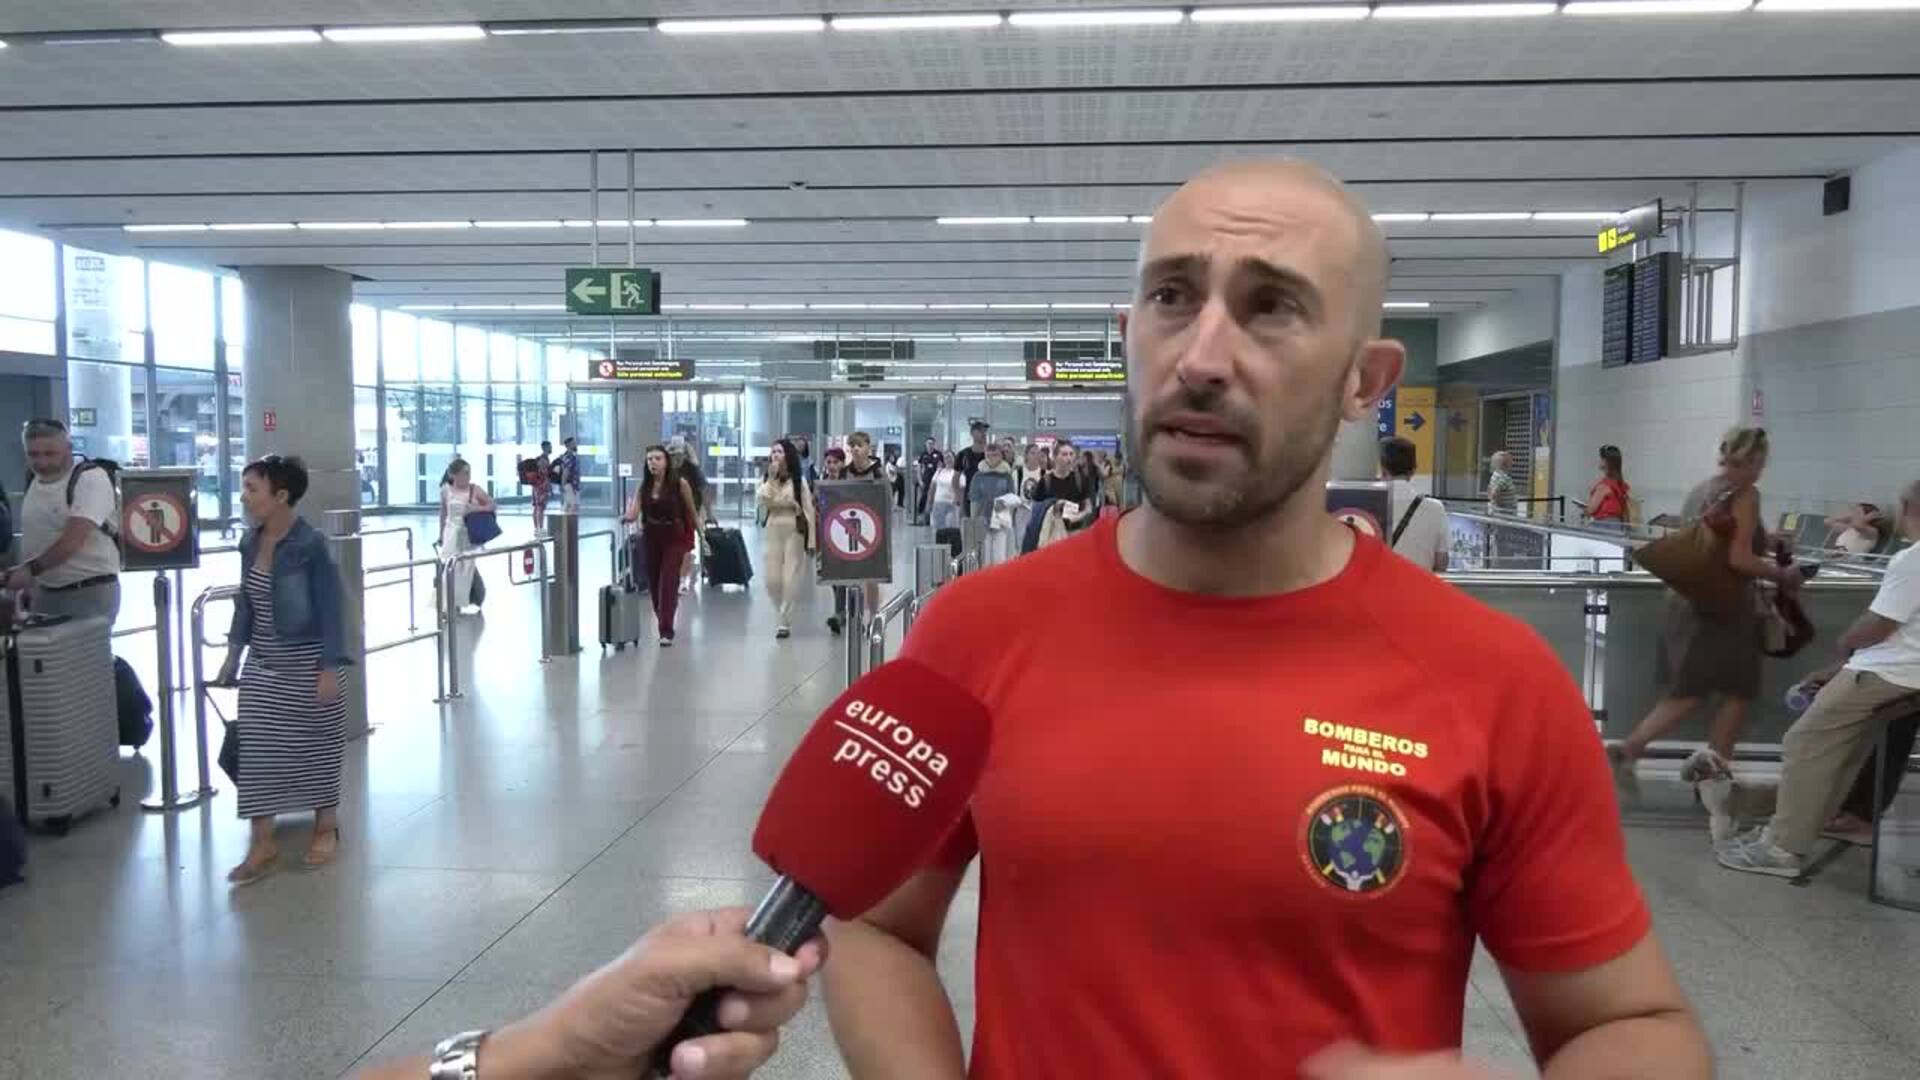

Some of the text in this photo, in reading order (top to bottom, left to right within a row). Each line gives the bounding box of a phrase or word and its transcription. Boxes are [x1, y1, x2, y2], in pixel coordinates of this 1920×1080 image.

[845, 700, 949, 777] europa
[1303, 717, 1429, 758] BOMBEROS
[1321, 749, 1407, 777] MUNDO
[833, 739, 925, 808] press
